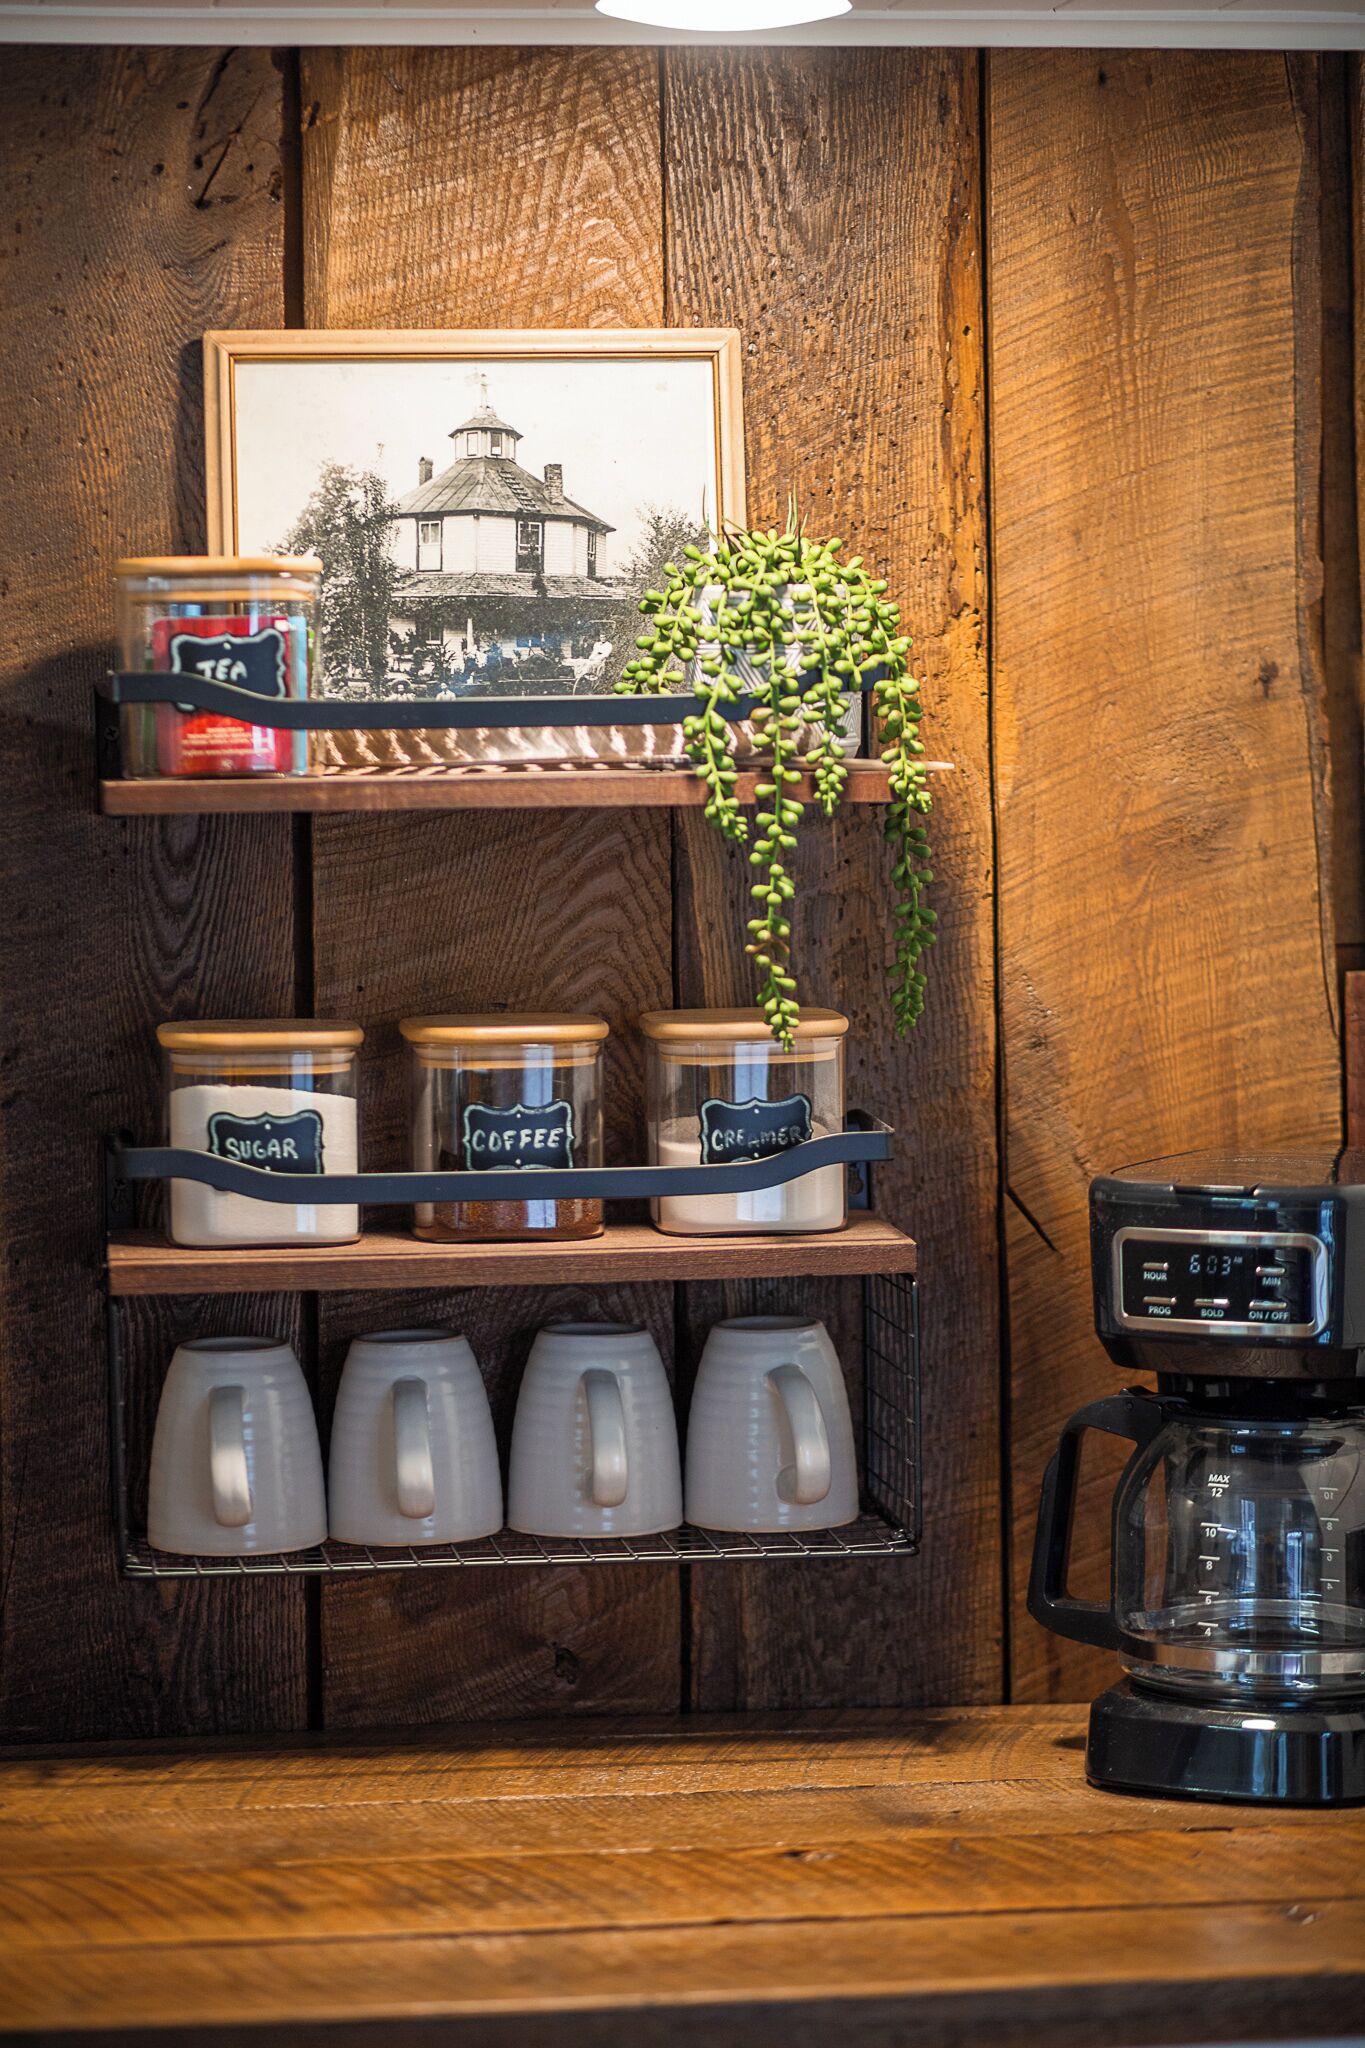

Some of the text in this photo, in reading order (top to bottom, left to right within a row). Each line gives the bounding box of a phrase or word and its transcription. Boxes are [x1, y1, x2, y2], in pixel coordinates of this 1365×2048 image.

[196, 658, 247, 682] TEA
[472, 1127, 564, 1152] COFFEE
[711, 1124, 806, 1152] CREAMER
[224, 1137, 299, 1161] SUGAR
[1143, 1271, 1167, 1281] HOUR
[1262, 1277, 1281, 1286] MIN
[1148, 1306, 1171, 1316] PROG
[1201, 1308, 1224, 1318] BOLD
[1249, 1311, 1263, 1319] ON
[1272, 1311, 1288, 1321] OFF
[1208, 1474, 1230, 1483] MAX
[1211, 1488, 1223, 1497] 12
[1205, 1528, 1217, 1537] 10
[1206, 1561, 1212, 1570] 8
[1205, 1596, 1211, 1605] 6
[1205, 1627, 1211, 1636] 4
